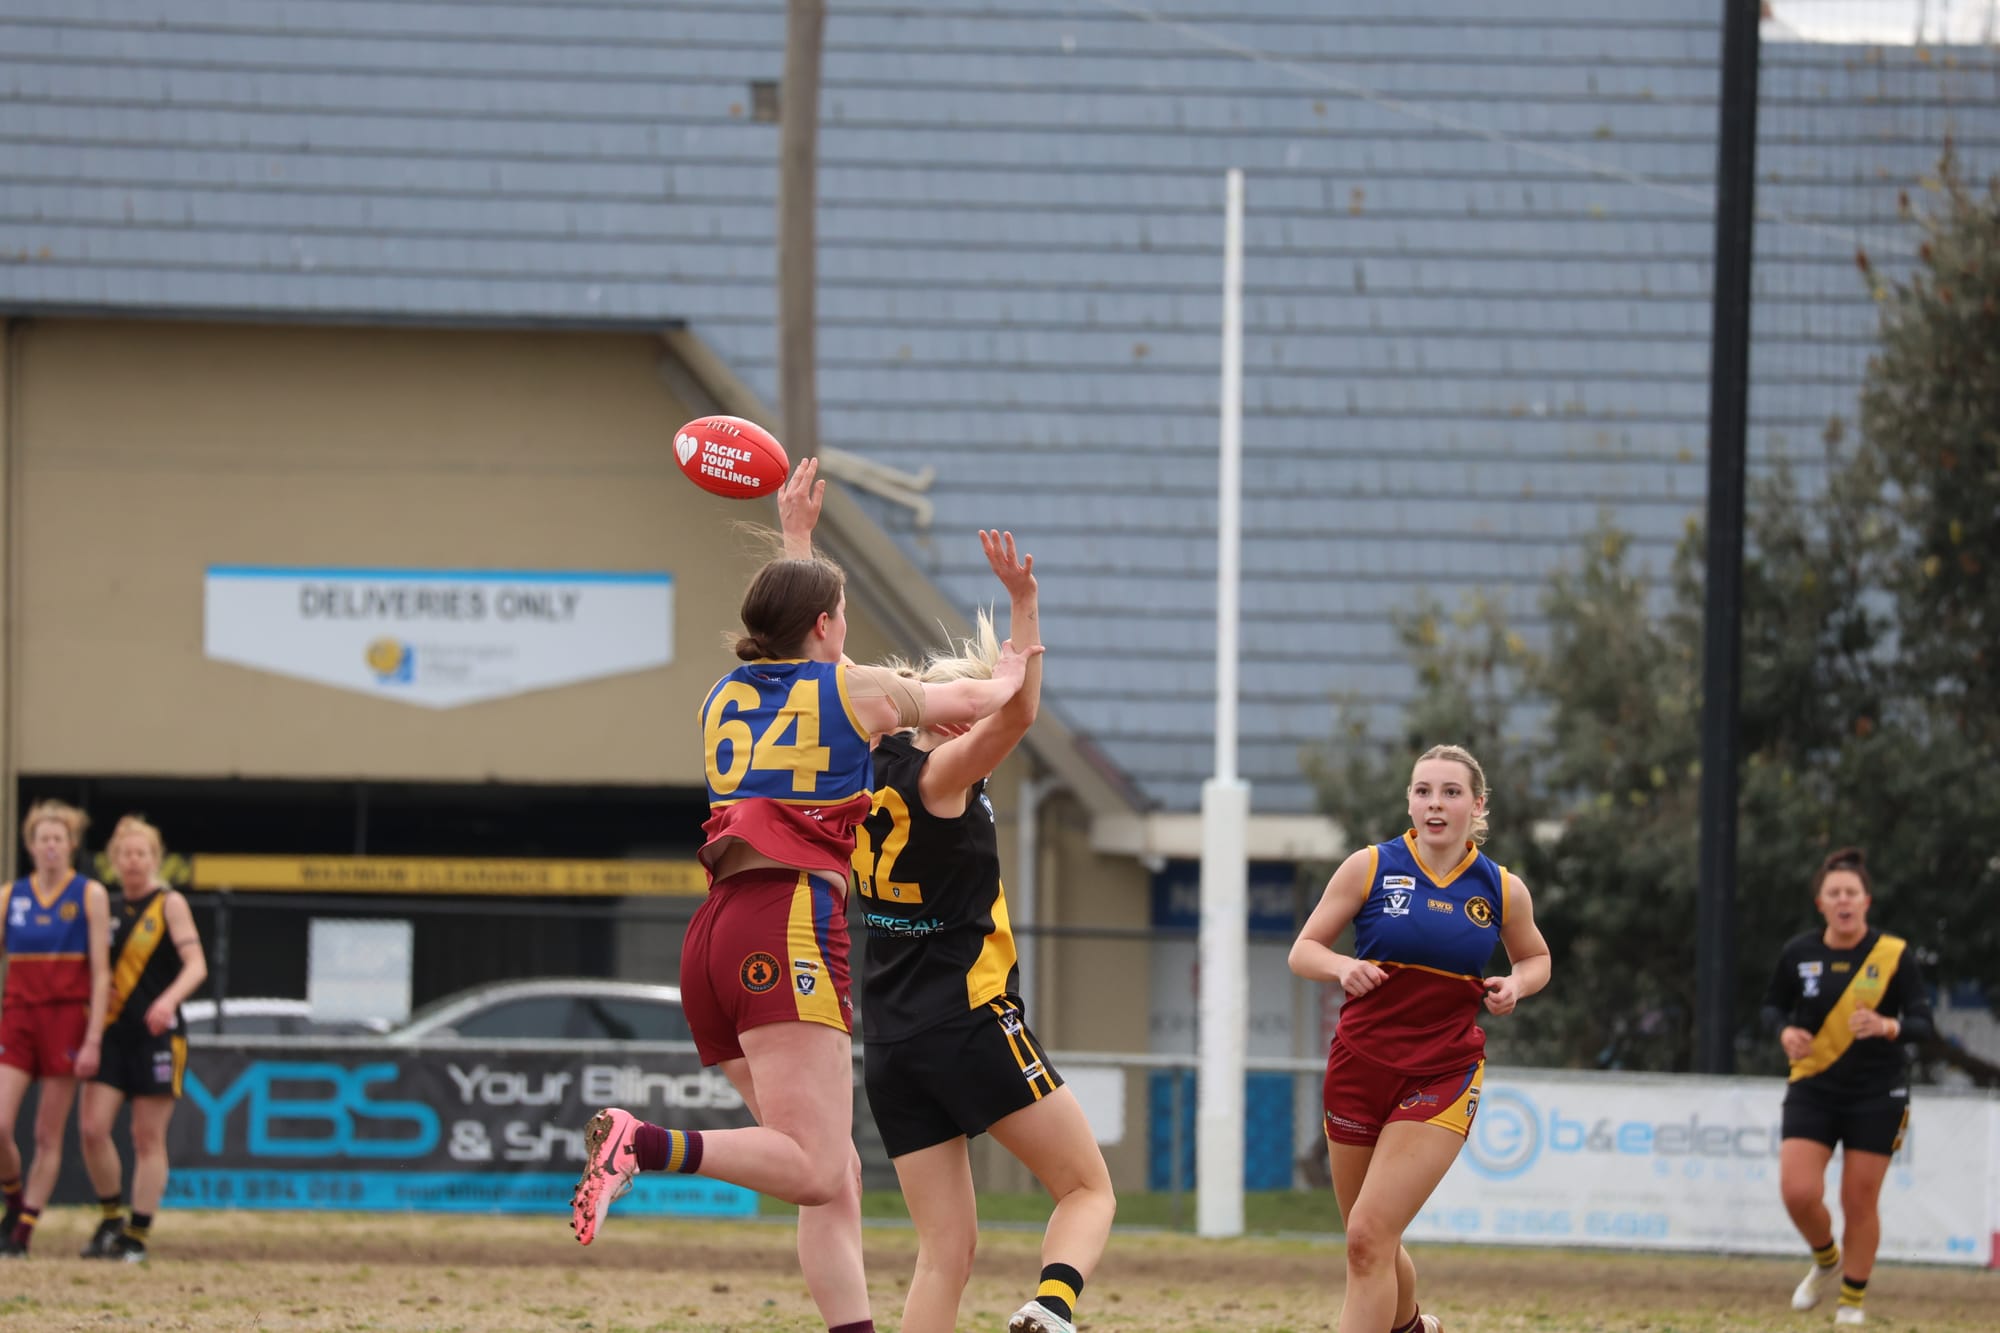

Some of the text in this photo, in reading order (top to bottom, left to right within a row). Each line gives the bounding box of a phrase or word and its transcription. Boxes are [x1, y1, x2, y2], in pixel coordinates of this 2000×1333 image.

[702, 452, 734, 470] YOUR
[704, 441, 752, 463] TACKLE
[701, 464, 760, 488] FEELINGS
[300, 585, 581, 622] DELIVERIES ONLY
[704, 679, 831, 795] 64
[759, 954, 778, 971] HOTEL
[448, 1063, 745, 1109] Your Blinds
[182, 1060, 442, 1159] YBS
[450, 1119, 494, 1162] &
